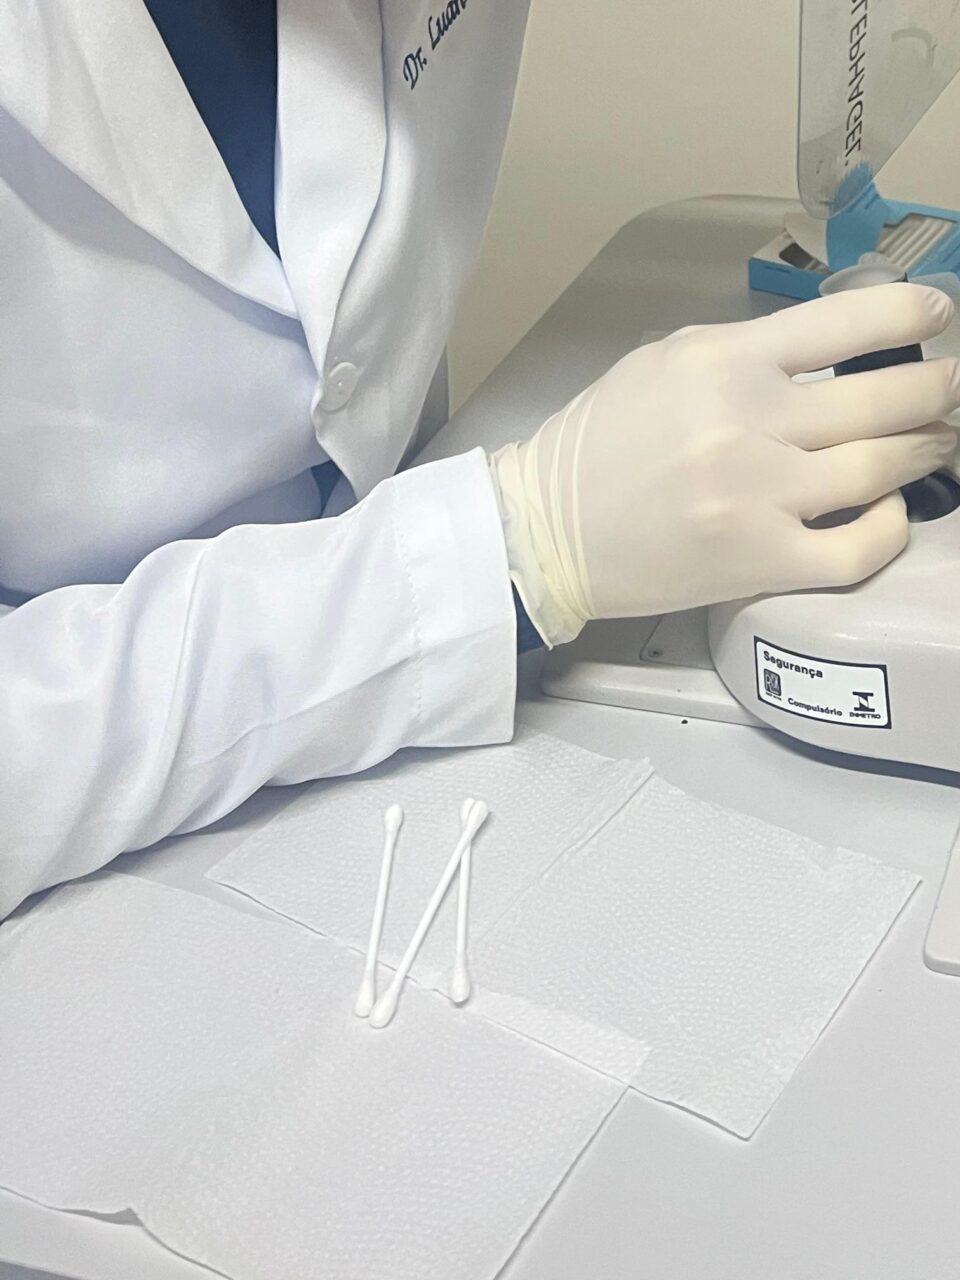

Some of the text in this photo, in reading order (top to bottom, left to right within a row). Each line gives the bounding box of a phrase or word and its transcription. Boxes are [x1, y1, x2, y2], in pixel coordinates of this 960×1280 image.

[403, 47, 427, 90] Dr.
[763, 650, 824, 678] Segurança
[787, 697, 843, 717] Compulsório
